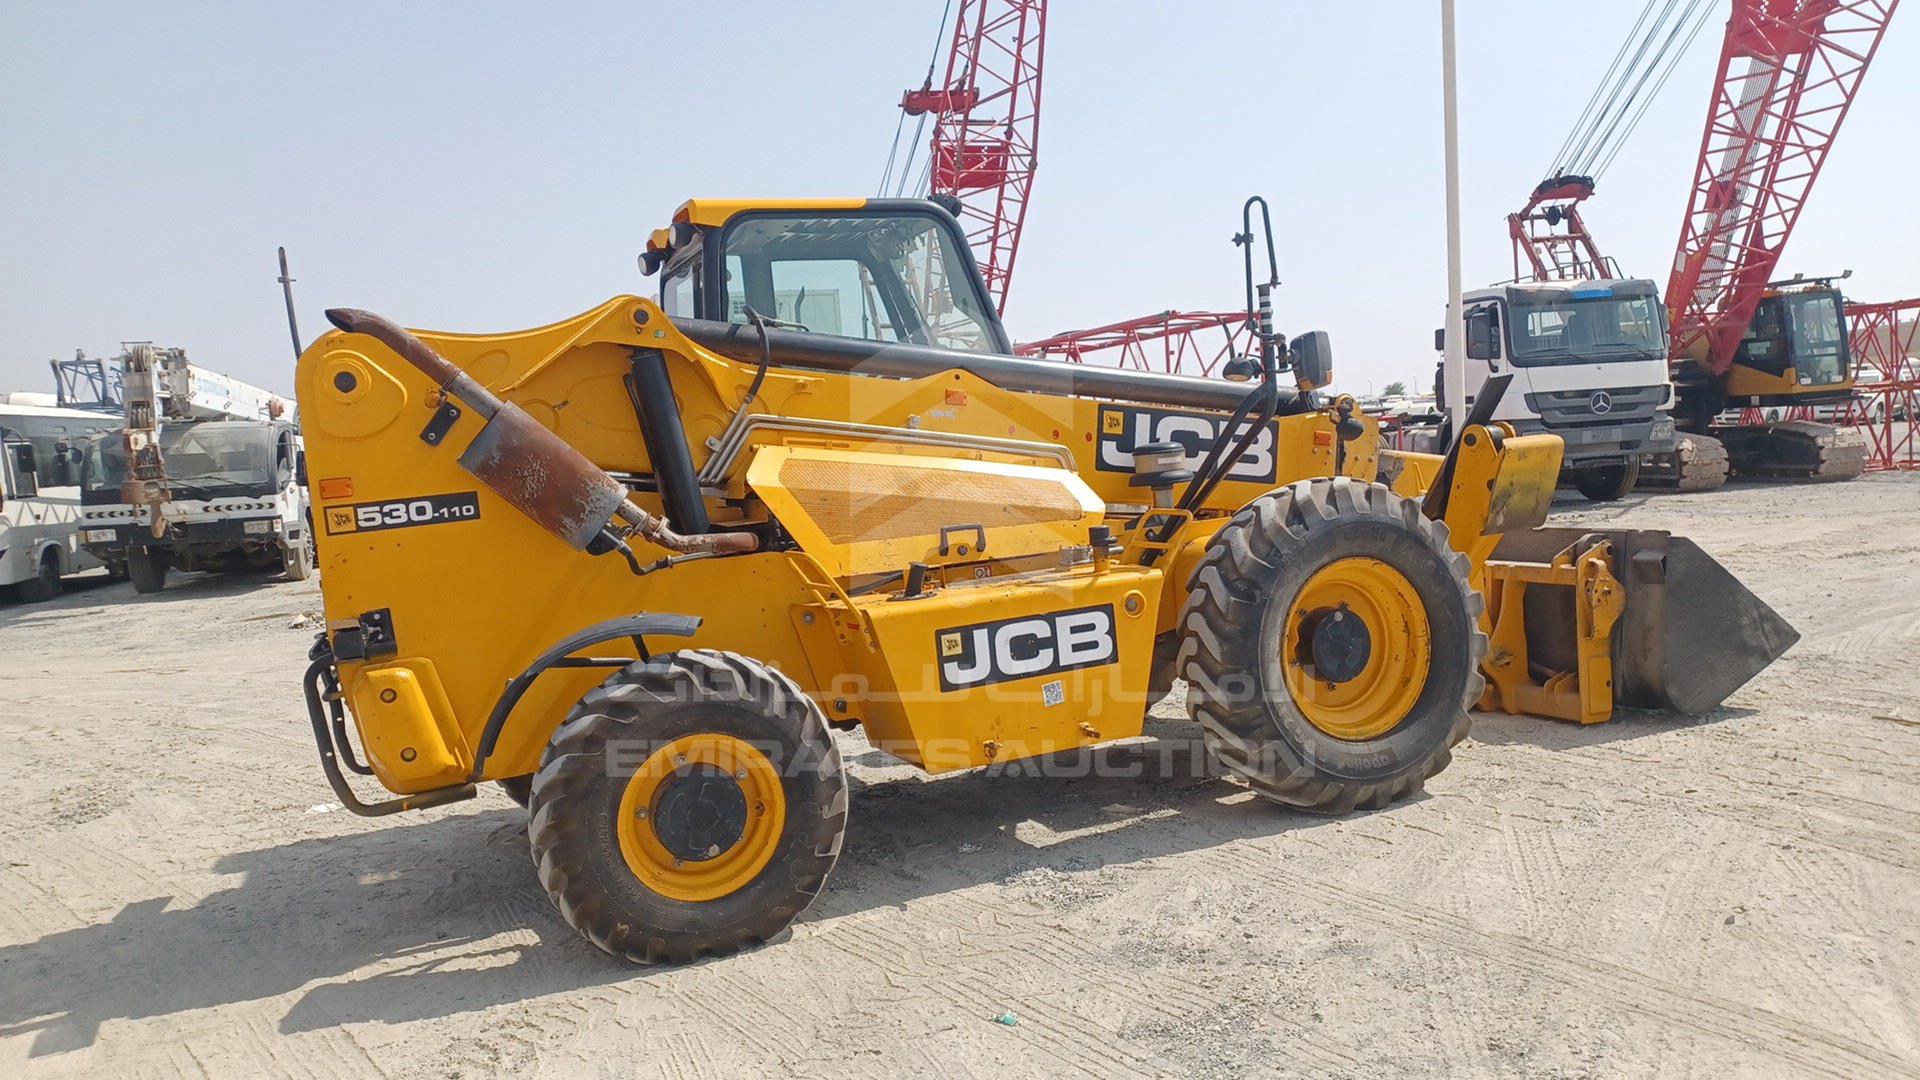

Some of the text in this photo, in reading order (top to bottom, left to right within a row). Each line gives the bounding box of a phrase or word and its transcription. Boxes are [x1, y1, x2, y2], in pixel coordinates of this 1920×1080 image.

[1102, 413, 1273, 477] JCB
[356, 500, 475, 528] 530-110
[943, 611, 1113, 685] JCB
